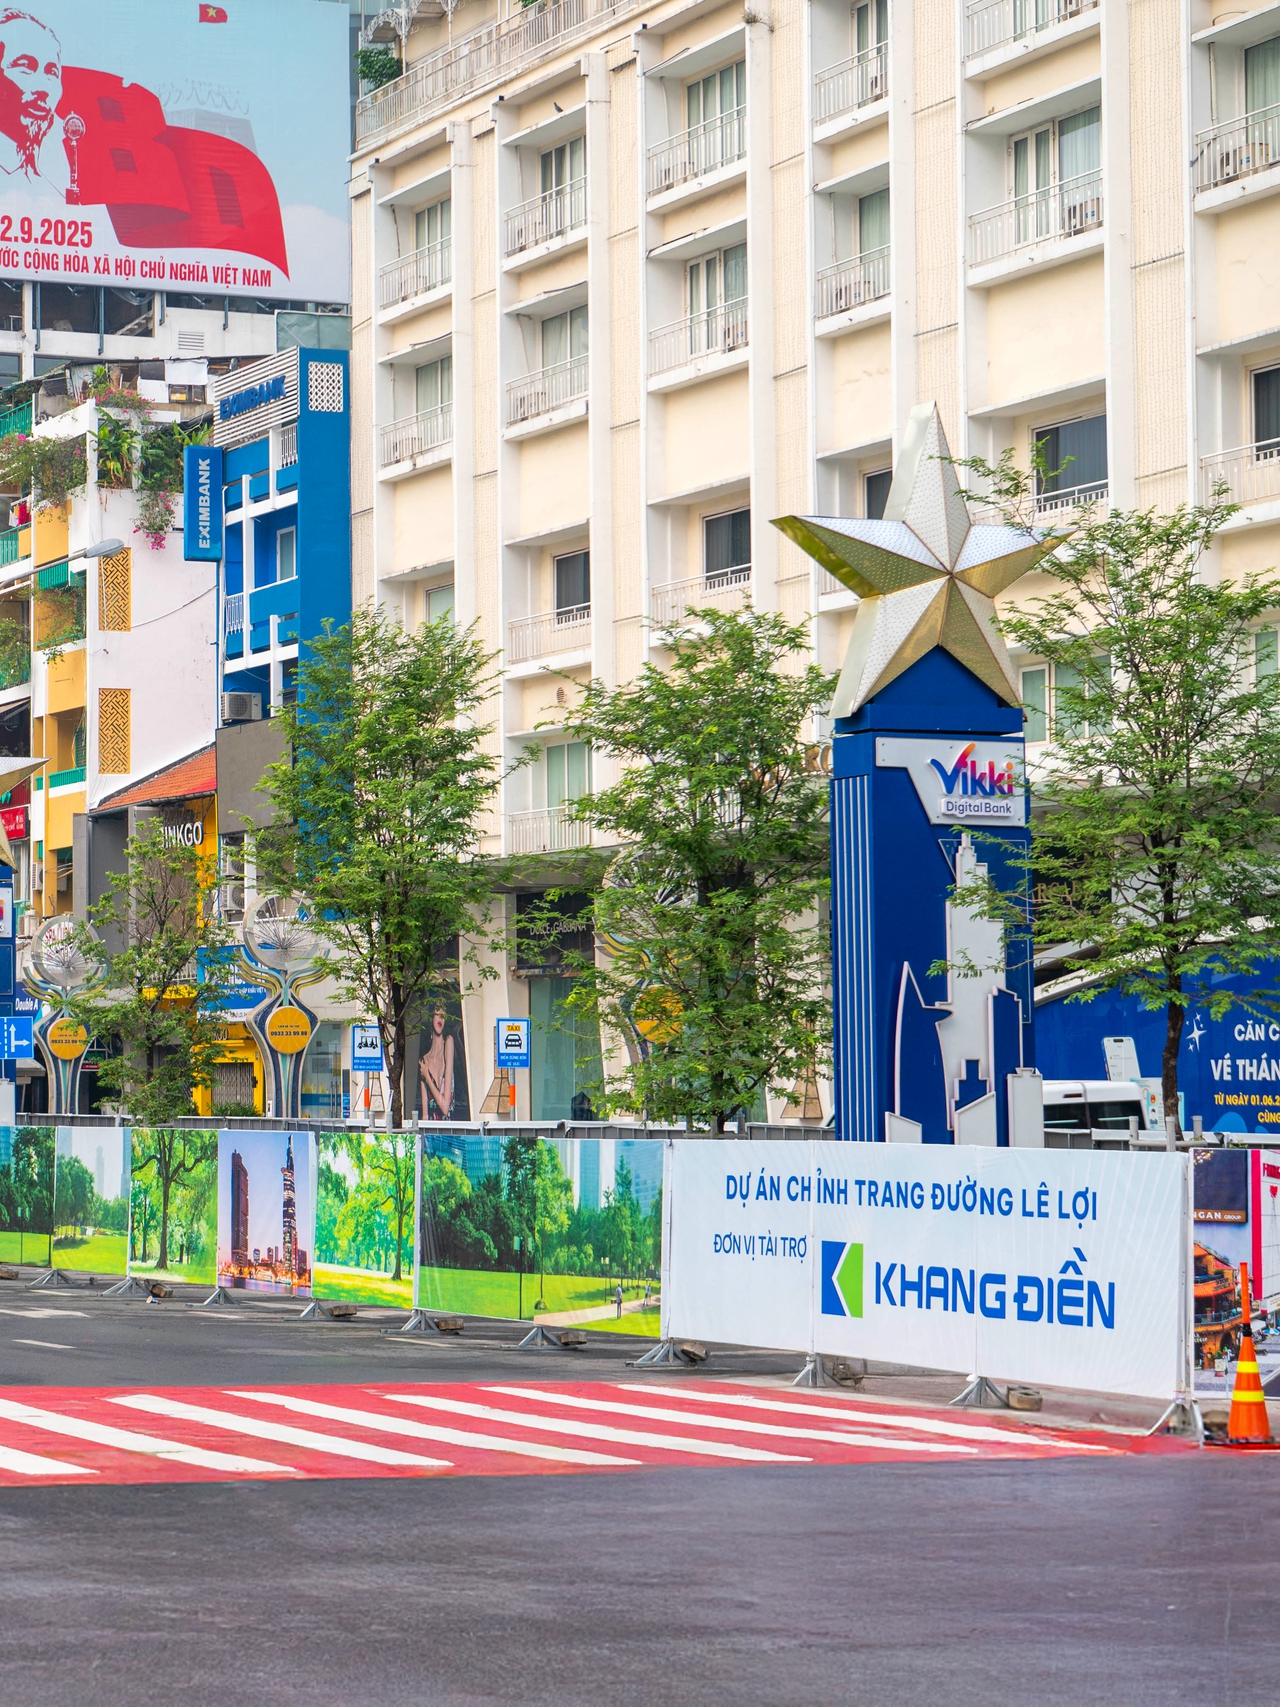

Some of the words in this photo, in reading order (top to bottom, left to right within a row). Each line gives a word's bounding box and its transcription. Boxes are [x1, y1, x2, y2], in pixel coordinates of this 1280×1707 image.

[24, 248, 59, 274] CỘNG
[63, 251, 90, 273] HÒA
[93, 253, 111, 275] XÃ
[114, 255, 136, 281] HỘI
[140, 255, 166, 279] CHỦ
[170, 260, 208, 283] NGHĨA
[212, 263, 239, 289] VIỆT
[242, 268, 272, 287] NAM
[219, 375, 287, 421] EXIMBANK
[198, 458, 211, 549] EXIMBANK
[929, 742, 1014, 796] Vikki
[946, 801, 983, 815] Digital
[984, 802, 1012, 814] Bank
[15, 998, 33, 1011] Double
[33, 998, 39, 1010] A
[1234, 1020, 1266, 1041] CĂN
[1210, 1053, 1232, 1081] VÉ
[1214, 1092, 1224, 1105] TỪ
[1225, 1092, 1249, 1106] NGÀY
[1257, 1109, 1280, 1123] CÙNG
[726, 1172, 751, 1208] DỰ
[755, 1167, 781, 1201] ÁN
[854, 1179, 925, 1209] TRANG
[930, 1175, 1013, 1216] ĐƯỜNG
[1021, 1181, 1050, 1218] LÊ
[1058, 1187, 1097, 1229] LỢI
[713, 1231, 741, 1254] ĐƠN
[743, 1235, 756, 1261] VỊ
[758, 1229, 778, 1257] TÀI
[780, 1235, 807, 1264] TRỢ
[875, 1261, 1007, 1320] KHANG
[1013, 1246, 1115, 1330] ĐIỀN
